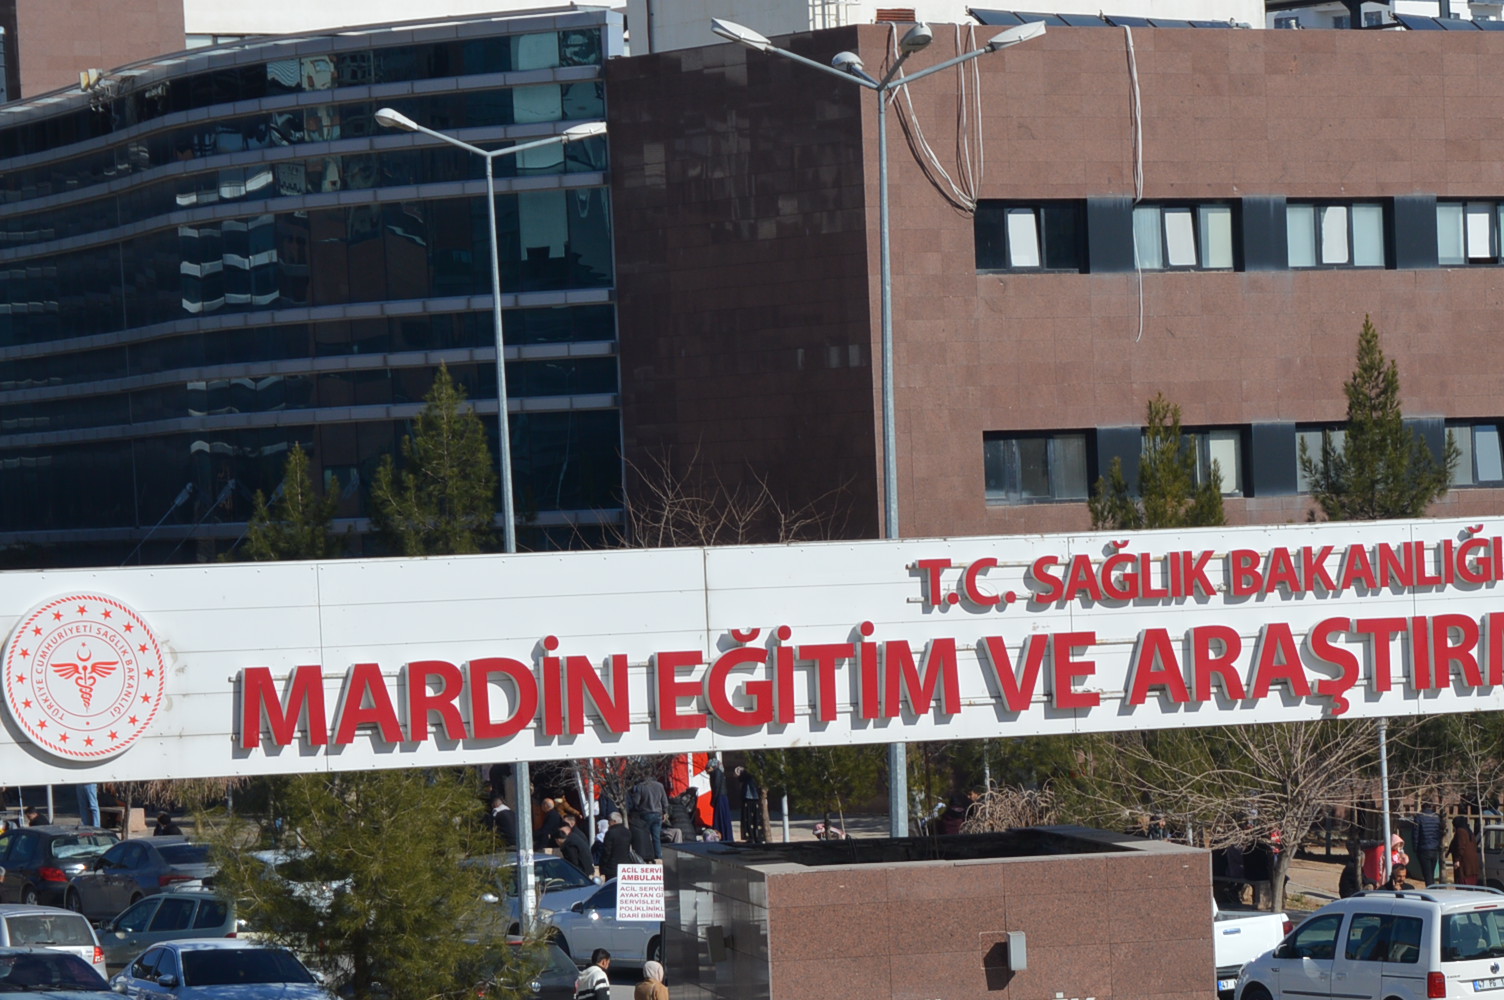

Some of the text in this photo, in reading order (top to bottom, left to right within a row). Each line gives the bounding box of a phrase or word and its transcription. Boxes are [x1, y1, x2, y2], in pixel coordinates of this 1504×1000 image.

[917, 523, 1504, 606] T.C. SAĞLIK BAKANLIĞI
[36, 624, 135, 721] TÜRKİYE CUMHURİYETİ SAĞLIK BAKANLIĞI
[243, 636, 631, 749] MARDİN
[657, 622, 962, 731] EĞİTİM
[986, 632, 1101, 712] VE
